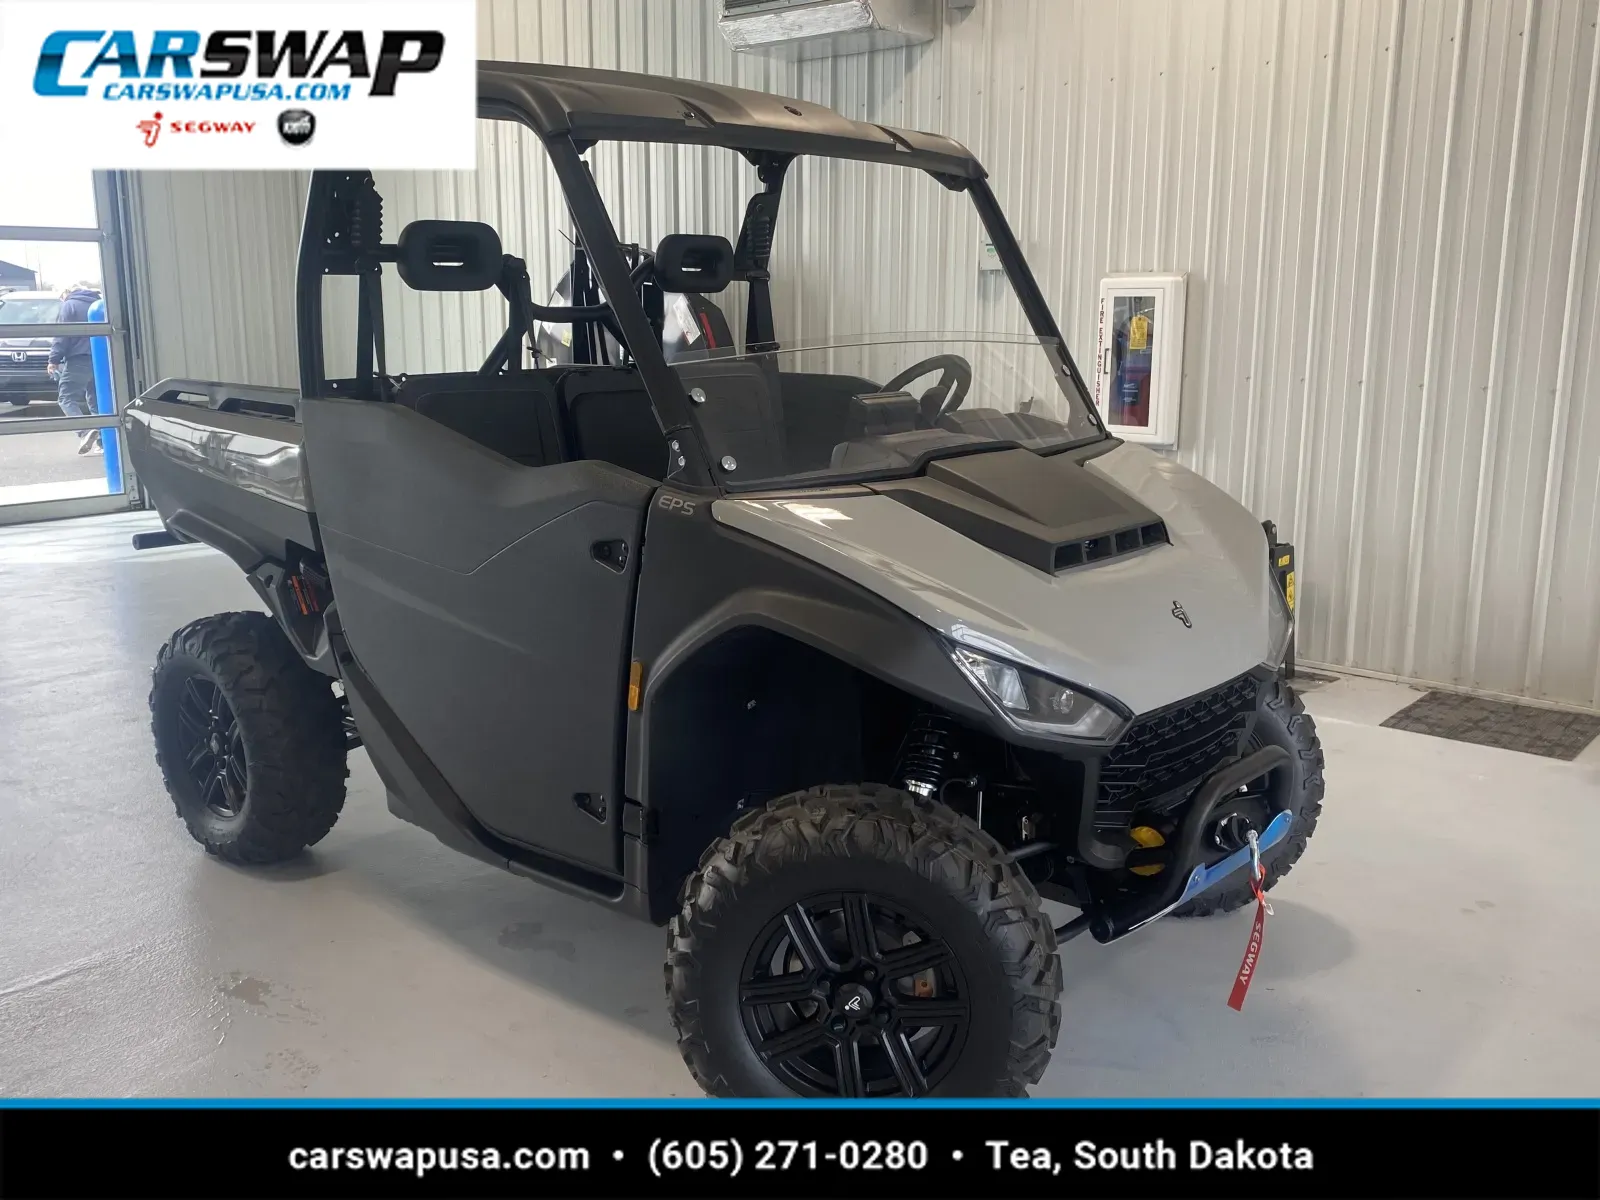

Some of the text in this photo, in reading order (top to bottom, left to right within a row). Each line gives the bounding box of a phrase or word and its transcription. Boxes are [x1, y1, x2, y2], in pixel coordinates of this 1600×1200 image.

[1095, 328, 1104, 407] EXTINGUISHER
[658, 495, 696, 516] EPS
[1239, 921, 1262, 985] SEGWAY
